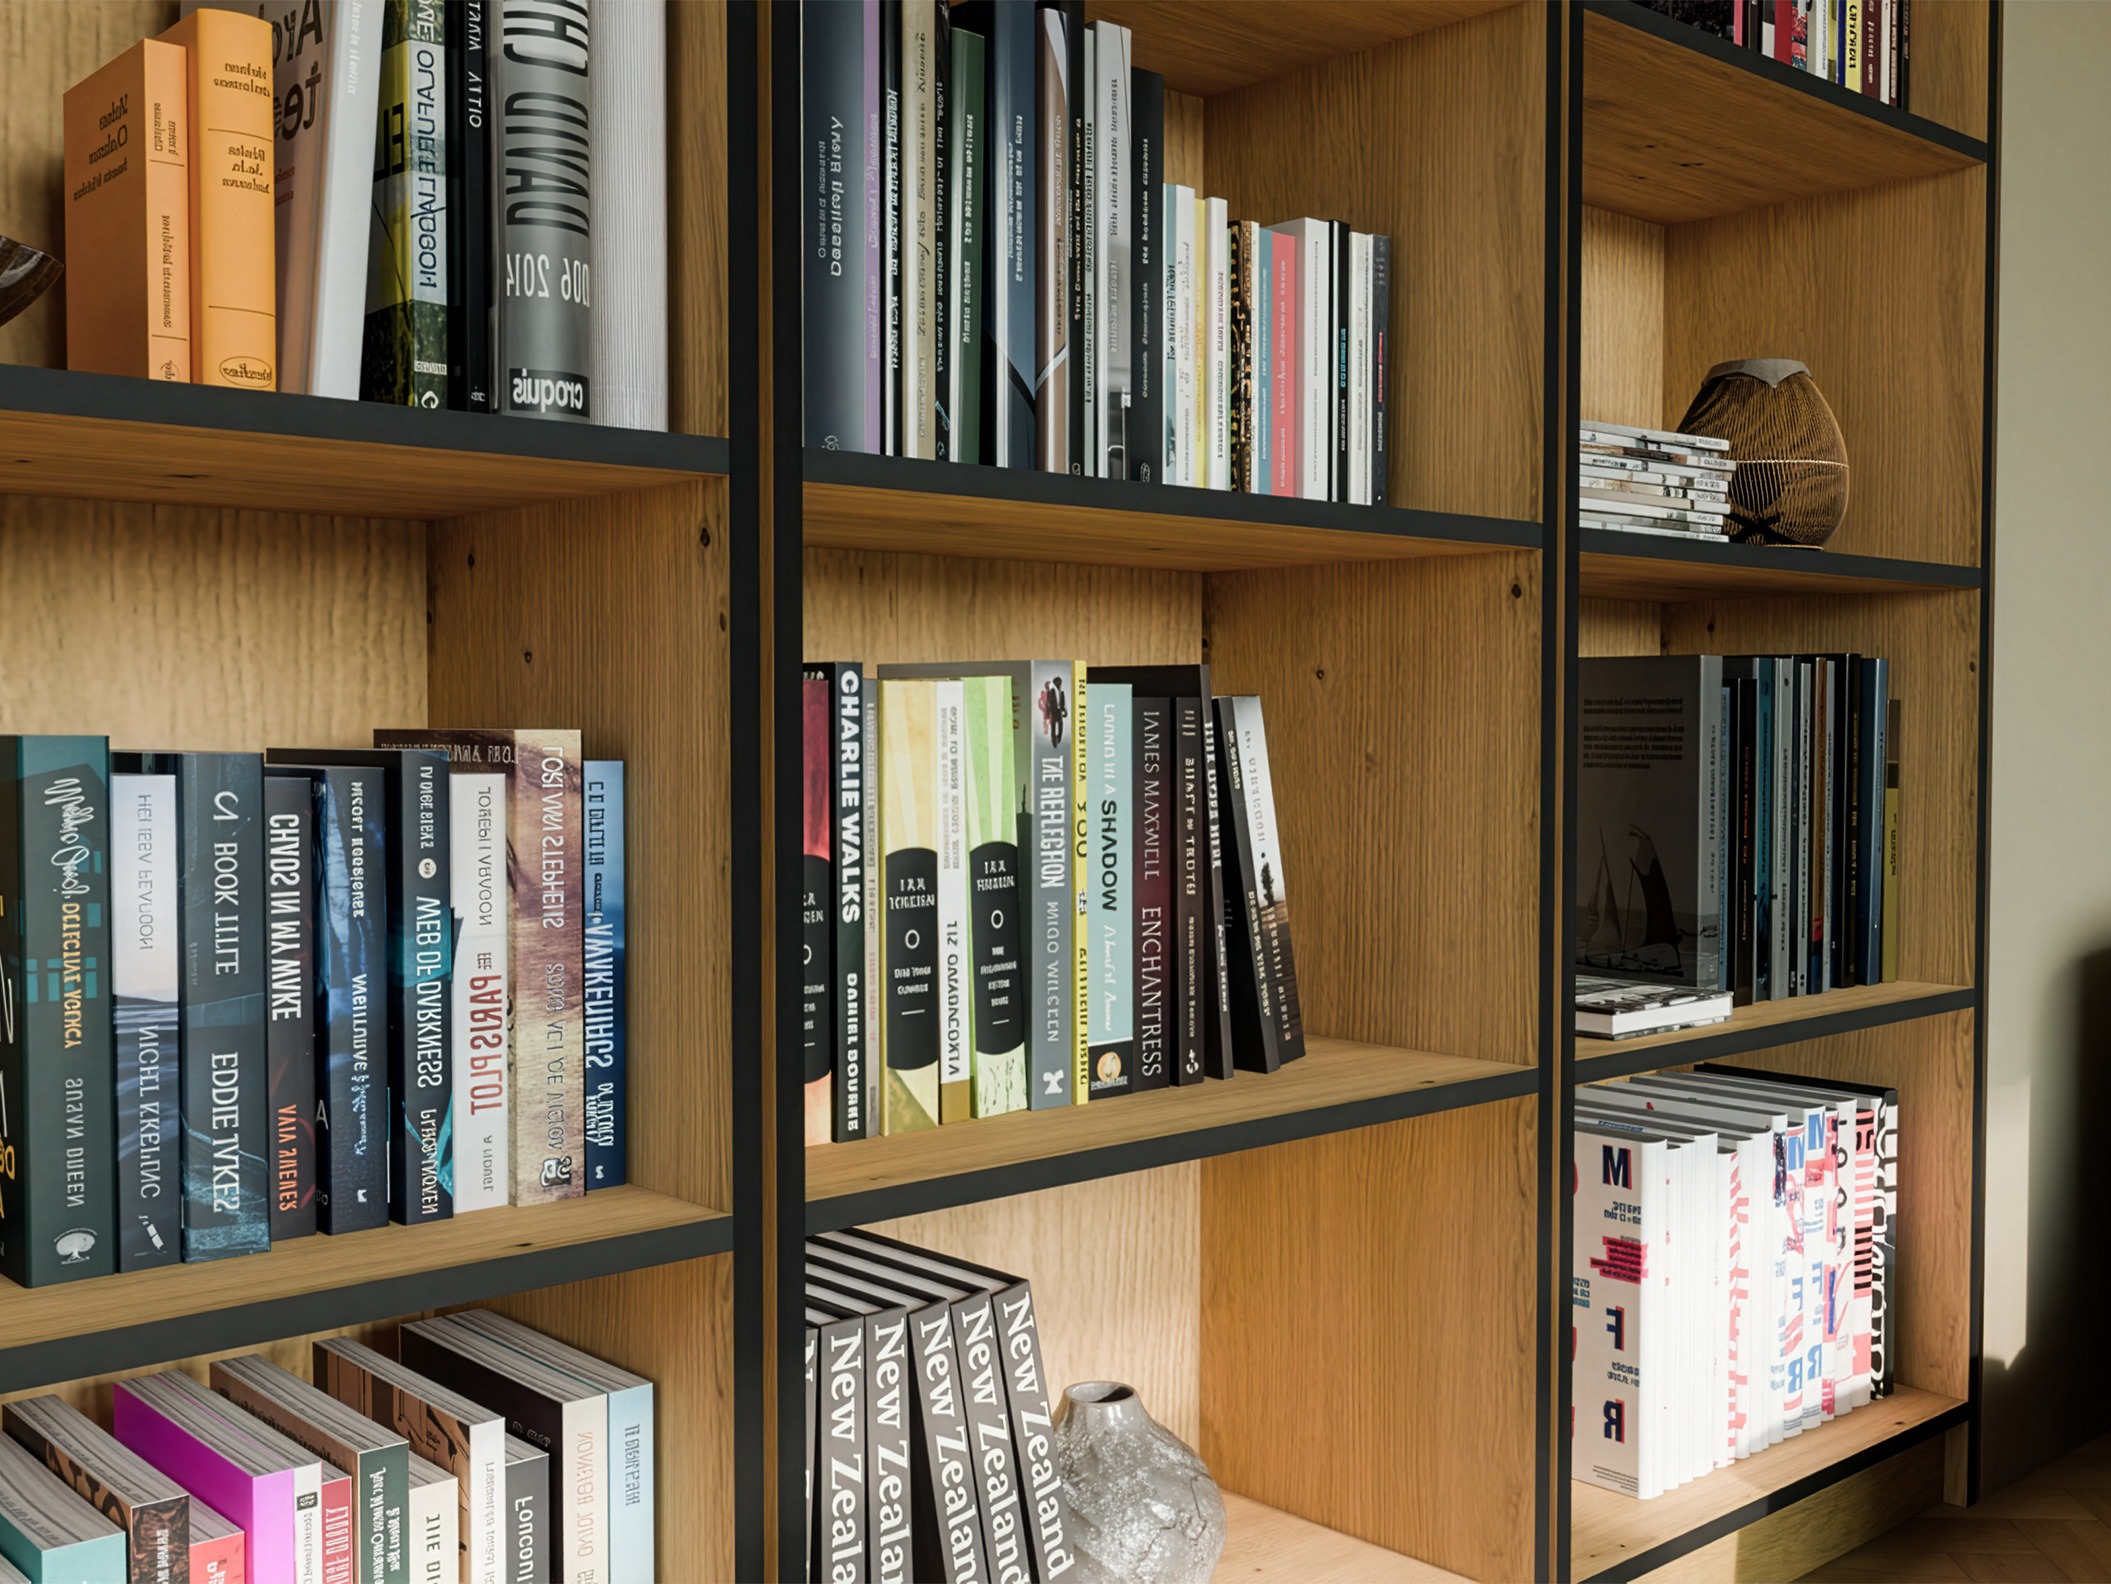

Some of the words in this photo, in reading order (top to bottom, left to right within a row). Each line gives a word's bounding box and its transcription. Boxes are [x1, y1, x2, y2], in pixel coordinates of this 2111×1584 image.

[840, 670, 861, 808] CHARLIE
[840, 811, 861, 925] WALKS
[1101, 799, 1118, 911] SHADOW
[1141, 906, 1162, 1077] ENCHANTRESS
[830, 1328, 862, 1442] New
[873, 1317, 905, 1430] New
[919, 1311, 954, 1417] New
[961, 1301, 997, 1406] New
[1002, 1291, 1039, 1394] New
[1019, 1400, 1075, 1581] Zealand
